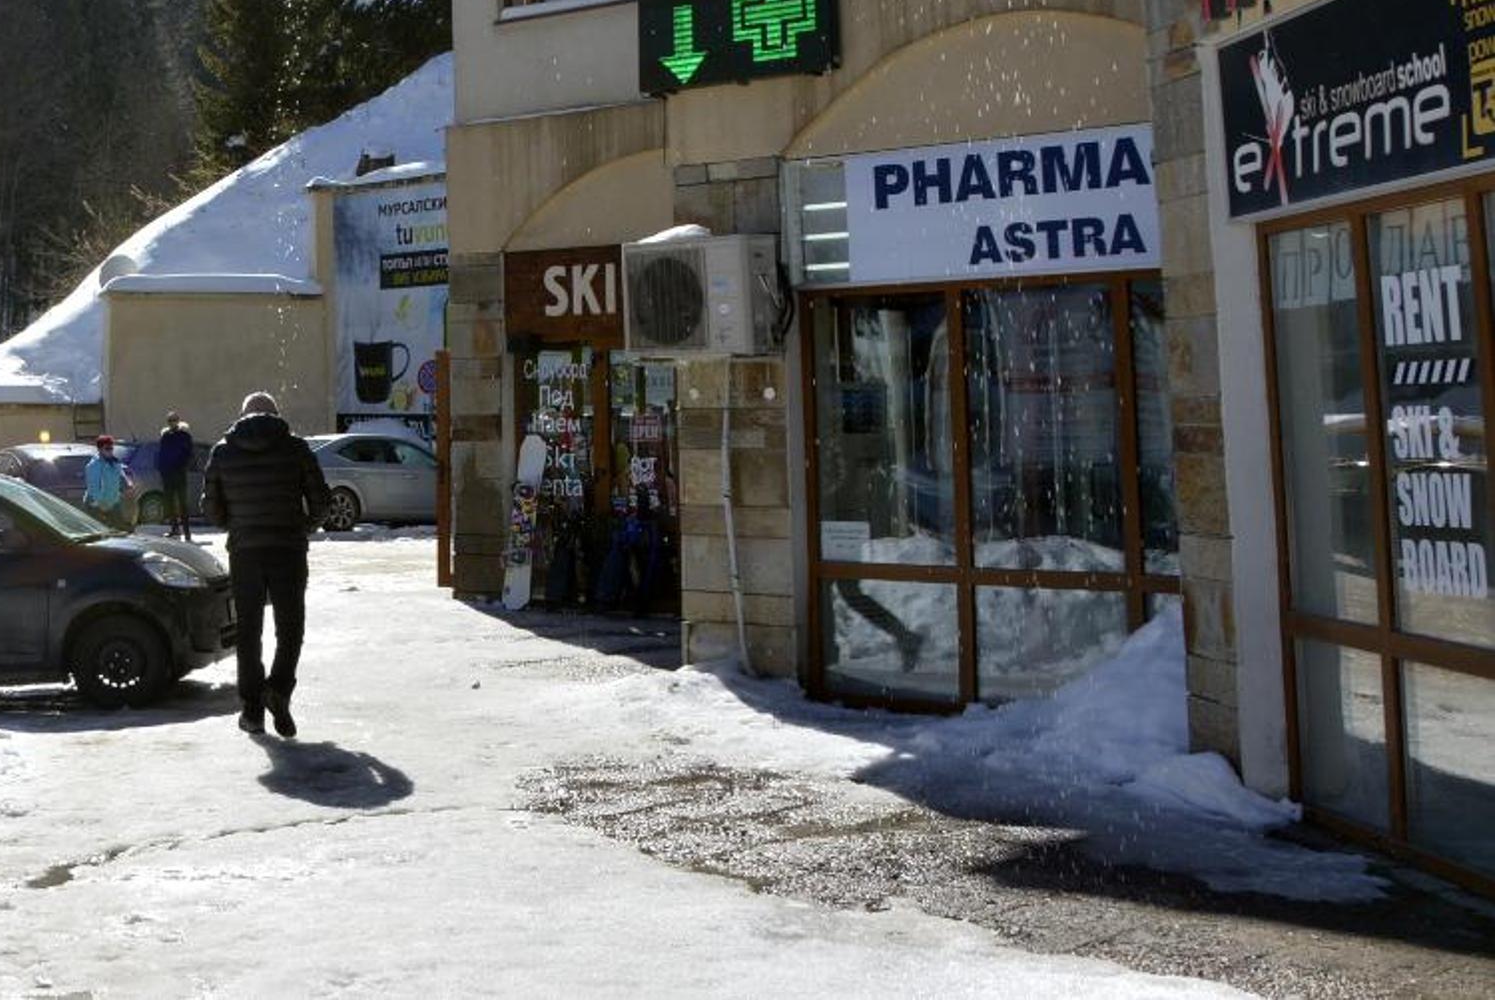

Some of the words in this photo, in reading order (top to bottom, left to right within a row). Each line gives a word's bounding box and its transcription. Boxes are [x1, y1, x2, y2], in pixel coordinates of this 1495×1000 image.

[1300, 87, 1316, 121] ski
[1319, 83, 1328, 116] &
[1330, 60, 1396, 110] snowboard
[1396, 42, 1446, 89] school
[873, 137, 1151, 209] PHARMA
[969, 214, 1147, 266] ASTRA
[543, 263, 616, 317] SKI
[1381, 265, 1463, 347] RENT
[1391, 404, 1432, 460] SKI
[1438, 406, 1460, 459] &
[1397, 472, 1472, 529] SNOW
[1400, 538, 1489, 599] BOARD
